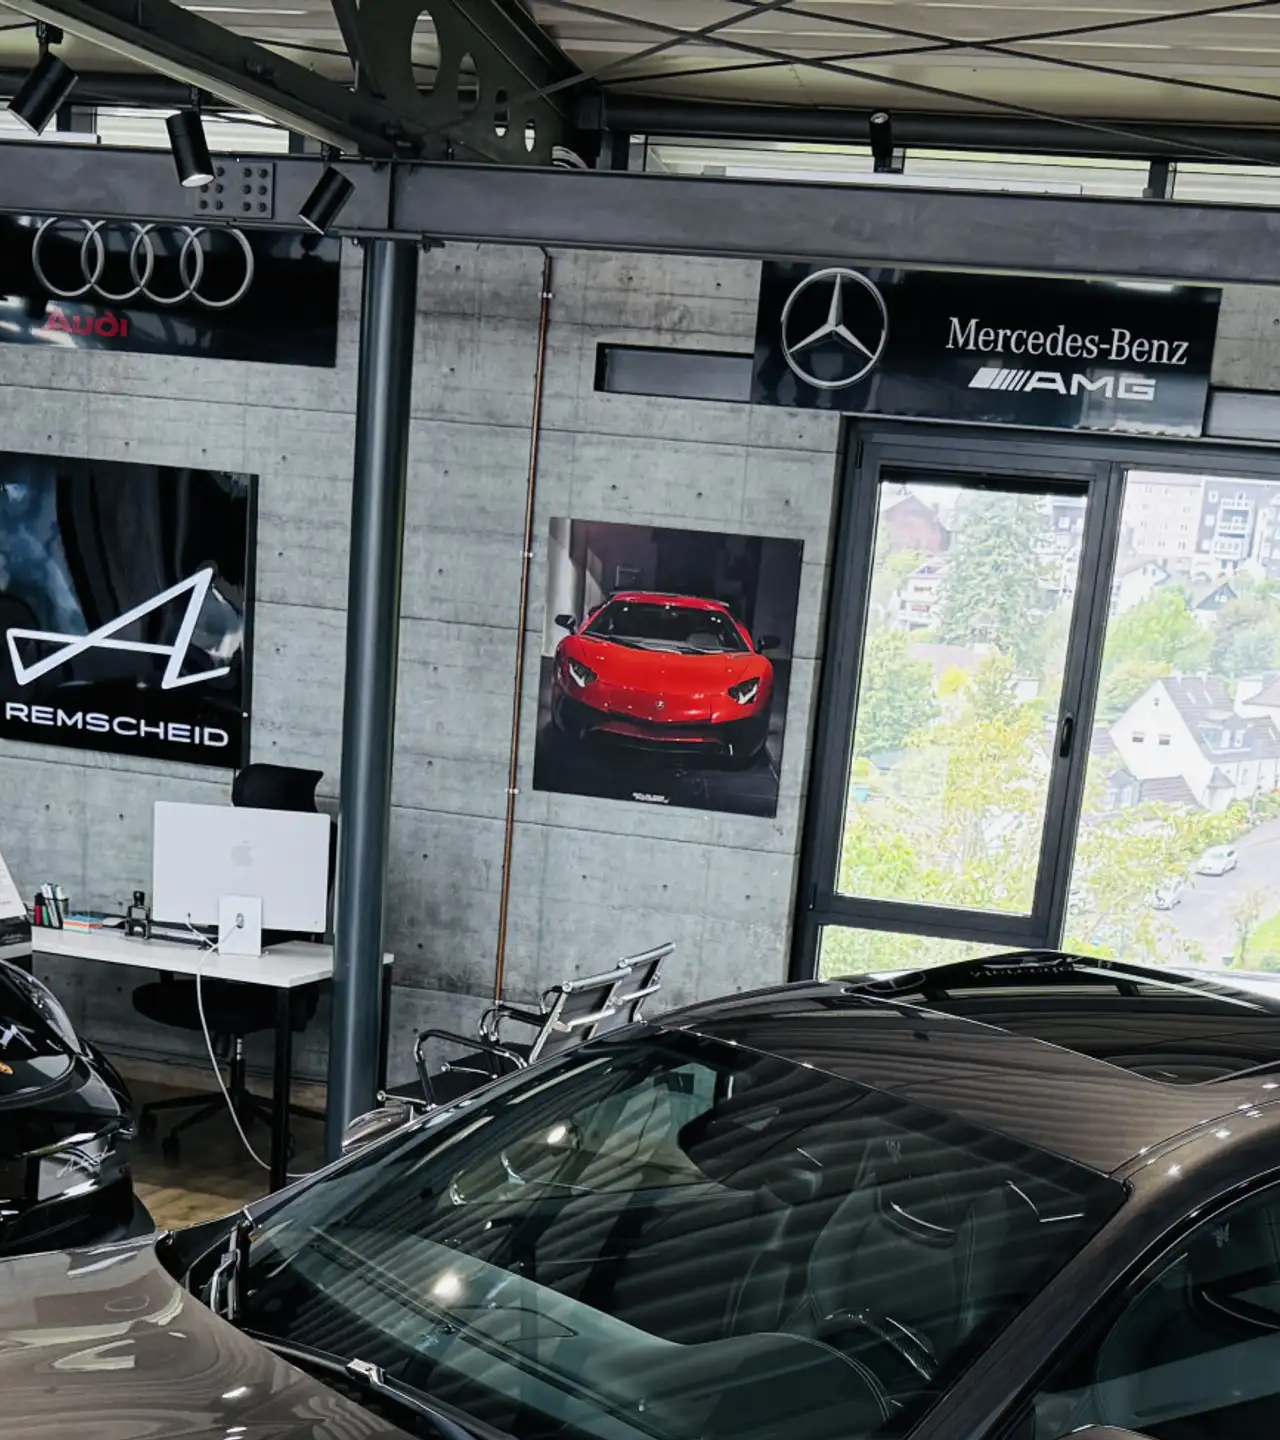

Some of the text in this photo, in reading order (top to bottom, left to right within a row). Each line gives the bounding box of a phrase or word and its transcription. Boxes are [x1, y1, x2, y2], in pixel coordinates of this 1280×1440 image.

[42, 310, 129, 339] Audi
[945, 316, 1190, 366] Mercedes-Benz
[1022, 370, 1157, 402] AMG
[4, 701, 230, 748] REMSCHEID
